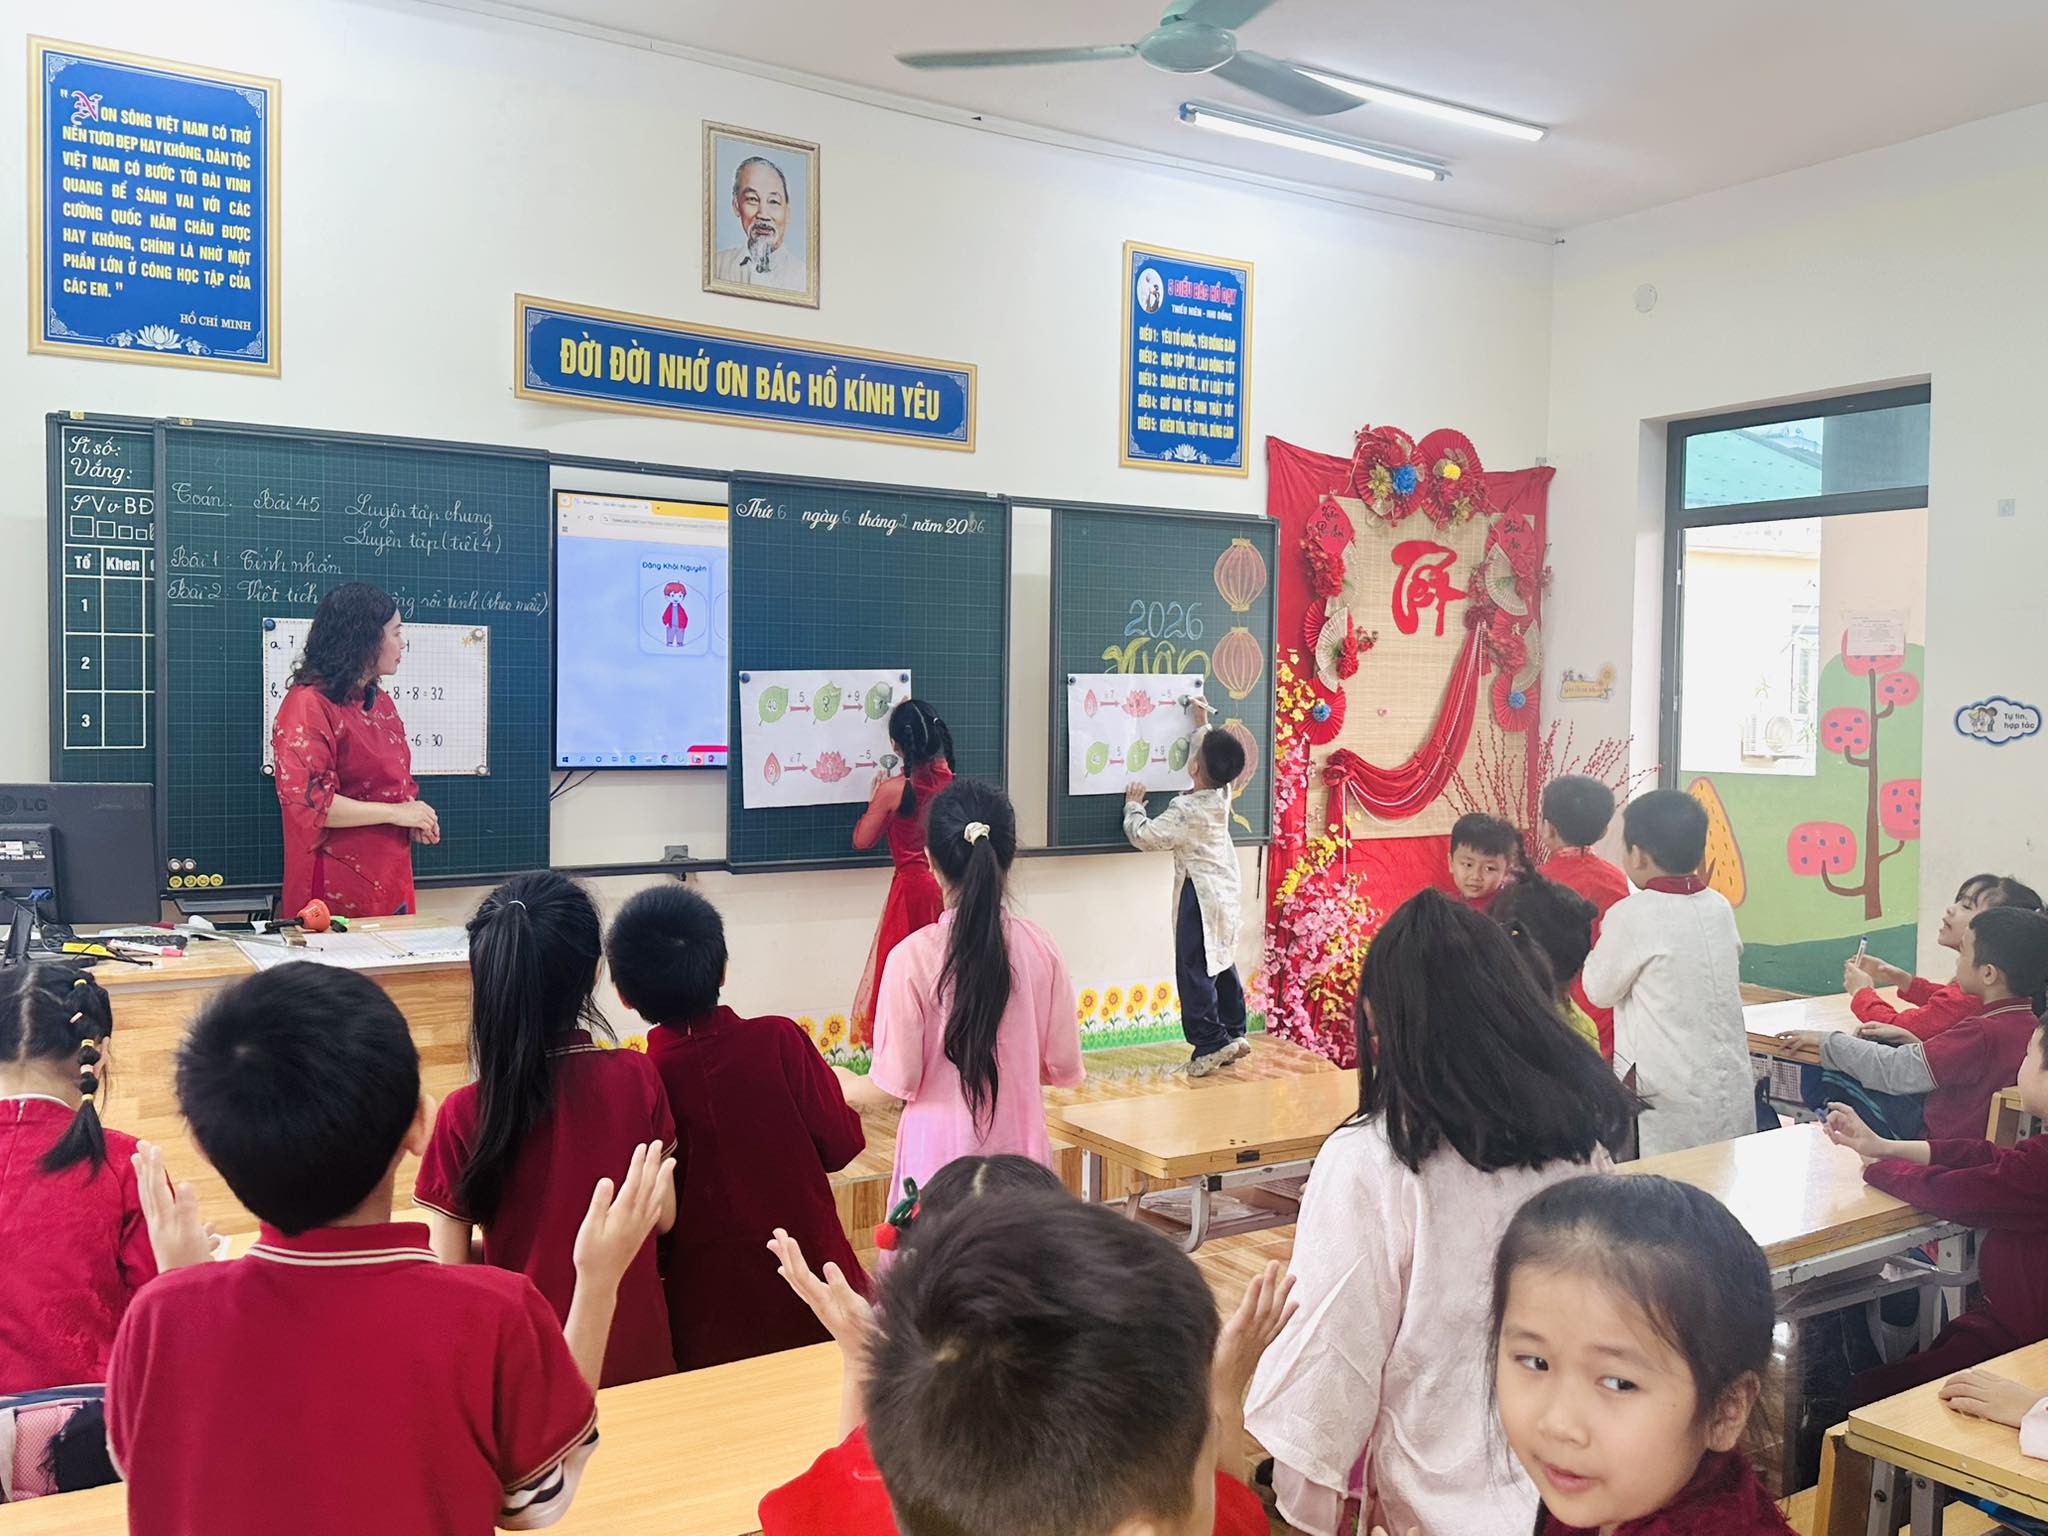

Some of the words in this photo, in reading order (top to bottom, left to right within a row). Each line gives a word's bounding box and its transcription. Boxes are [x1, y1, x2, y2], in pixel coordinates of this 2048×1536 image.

[121, 107, 151, 128] SÔNG
[156, 115, 179, 134] VIỆT
[183, 120, 208, 137] NAM
[212, 123, 226, 140] CÓ
[230, 126, 251, 144] TRỞ
[62, 124, 86, 142] NÊN
[88, 130, 114, 147] TƯƠI
[116, 134, 138, 152] ĐẸP
[140, 138, 162, 154] HAY
[164, 140, 205, 163] KHÔNG,
[206, 147, 229, 164] DÂN
[230, 150, 251, 169] TỘC
[63, 150, 87, 170] VIỆT
[92, 157, 119, 173] NAM
[125, 158, 140, 175] CÓ
[145, 161, 175, 181] BƯỚC
[180, 166, 197, 184] TỚI
[202, 169, 220, 188] ĐÀI
[226, 175, 250, 193] VINH
[63, 177, 102, 196] QUANG
[112, 179, 127, 199] ĐỂ
[136, 184, 167, 205] SÁNH
[176, 193, 194, 208] VAI
[202, 192, 220, 213] VỚI
[229, 197, 250, 217] CÁC
[63, 200, 102, 221] CƯỜNG
[112, 204, 142, 226] QUỐC
[150, 210, 176, 230] NĂM
[185, 217, 214, 236] CHÂU
[222, 223, 250, 242] ĐƯỢC
[63, 228, 85, 244] HAY
[92, 230, 134, 252] KHÔNG,
[141, 234, 174, 255] CHÍNH
[181, 239, 194, 258] LÀ
[200, 241, 223, 261] NHỜ
[228, 245, 251, 266] MỘT
[63, 252, 95, 271] PHẦN
[100, 255, 123, 274] LỚN
[128, 258, 136, 275] Ở
[141, 261, 171, 280] CÔNG
[176, 267, 199, 284] HỌC
[204, 268, 225, 288] TẬP
[229, 269, 251, 290] CỦA
[63, 277, 86, 294] CÁC
[90, 281, 111, 297] EM.
[1168, 278, 1173, 296] 5
[180, 309, 196, 324] HỒ
[199, 311, 218, 328] CHÍ
[221, 316, 251, 331] MINH
[560, 331, 601, 378] ĐỜI
[609, 339, 650, 386] ĐỜI
[659, 347, 707, 393] NHỚ
[716, 359, 748, 398] ƠN
[756, 363, 801, 405] BÁC
[808, 365, 837, 410] HỒ
[844, 375, 895, 416] KÍNH
[901, 381, 940, 421] YÊU
[93, 436, 121, 457] số:
[70, 458, 133, 485] Vắng:
[295, 496, 320, 512] 45
[445, 500, 494, 535] chung
[736, 498, 774, 520] Thứ
[777, 504, 787, 520] 6
[802, 510, 840, 530] ngày
[842, 507, 851, 524] 6
[858, 510, 898, 536] tháng
[899, 514, 908, 528] 2
[912, 519, 944, 533] năm
[74, 552, 91, 569] Tổ
[106, 556, 140, 571] Khen
[240, 547, 286, 571] Tính
[81, 598, 88, 612] 1
[1124, 600, 1204, 640] 2026
[81, 657, 90, 670] 2
[430, 687, 444, 700] 32
[81, 714, 91, 727] 3
[431, 734, 443, 747] 30
[22, 799, 48, 811] LG
